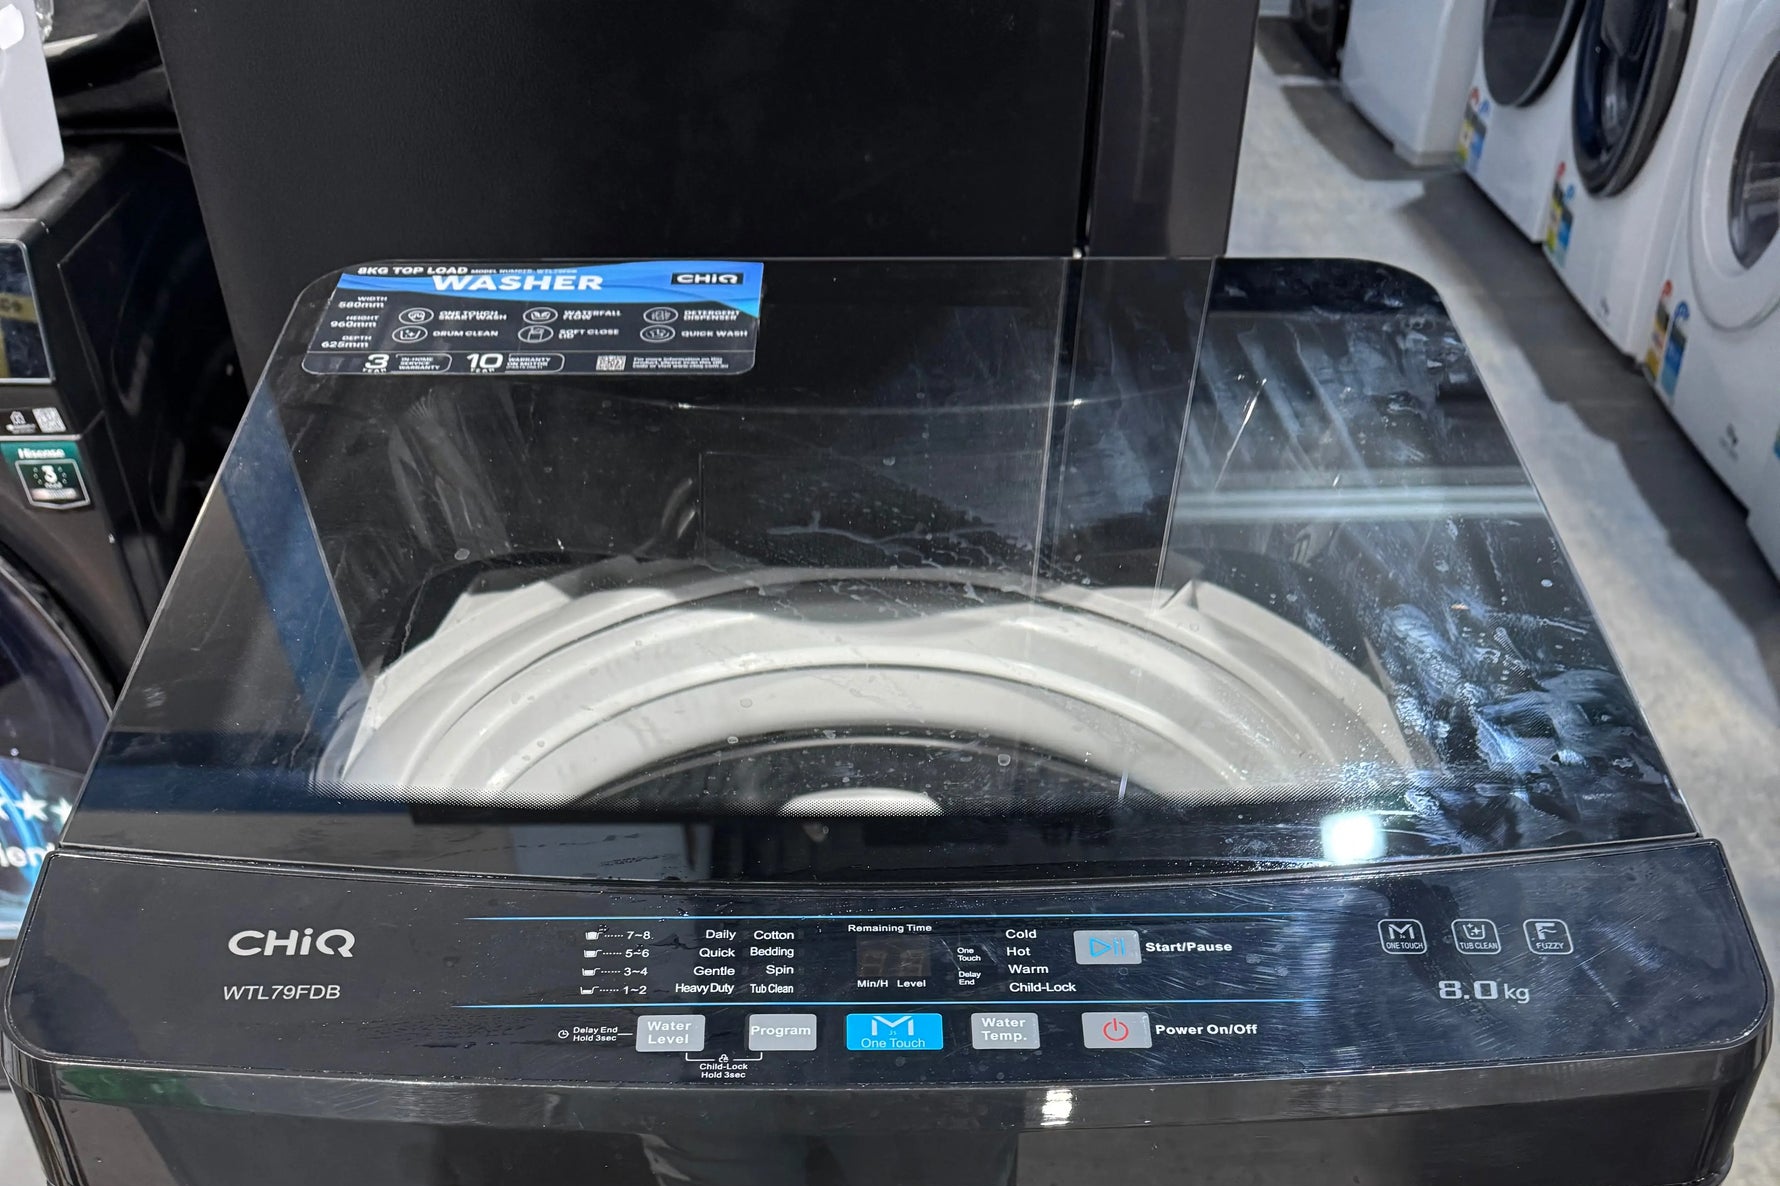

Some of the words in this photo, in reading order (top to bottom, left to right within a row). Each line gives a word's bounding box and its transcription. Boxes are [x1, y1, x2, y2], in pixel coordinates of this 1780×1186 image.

[357, 266, 389, 275] 8KG
[392, 266, 424, 275] TOP
[427, 266, 469, 275] LOAD
[432, 275, 603, 291] WASHER
[330, 320, 377, 328] 960mm
[364, 353, 390, 369] 3
[466, 353, 504, 369] 10
[848, 924, 905, 934] Remaining
[906, 924, 932, 932] Time
[1005, 929, 1037, 939] Cold
[705, 929, 737, 941] Daily
[753, 930, 795, 940] Cotton
[228, 928, 355, 958] CHiQ
[1145, 942, 1233, 952] Start/Pause
[1385, 942, 1400, 950] ONE
[1401, 942, 1424, 950] TOUCH
[1459, 942, 1475, 950] TUB
[1475, 942, 1499, 950] CLEAN
[1536, 942, 1564, 950] FUZZY
[699, 947, 736, 958] Quick
[750, 947, 795, 958] Bedding
[1006, 947, 1031, 956] Hot
[957, 954, 982, 962] Touch
[693, 966, 736, 976] Gentle
[765, 965, 794, 976] Spin
[1008, 965, 1049, 974] Warm
[958, 971, 982, 979] Delay
[750, 984, 767, 993] Tub
[768, 984, 794, 993] Clean
[857, 979, 889, 988] Min/H
[897, 979, 927, 988] Level
[1009, 982, 1077, 993] Child-Lock
[223, 985, 341, 1000] WTL79FDB
[675, 983, 709, 995] Heavy
[710, 983, 735, 995] Duty
[1438, 981, 1499, 1000] 8.0
[1503, 984, 1530, 1003] kg
[647, 1021, 692, 1031] Water
[981, 1018, 1026, 1028] Water
[573, 1027, 599, 1035] Delay
[751, 1026, 812, 1037] Program
[1156, 1025, 1203, 1035] Power
[1207, 1024, 1258, 1035] On/Off
[573, 1034, 594, 1042] Hold
[648, 1034, 689, 1044] Level
[981, 1031, 1028, 1042] Temp.
[861, 1038, 887, 1048] One
[889, 1038, 926, 1048] Touch
[699, 1063, 748, 1071] Child-Lock
[701, 1071, 723, 1079] Hold
[724, 1071, 746, 1079] 3sec
